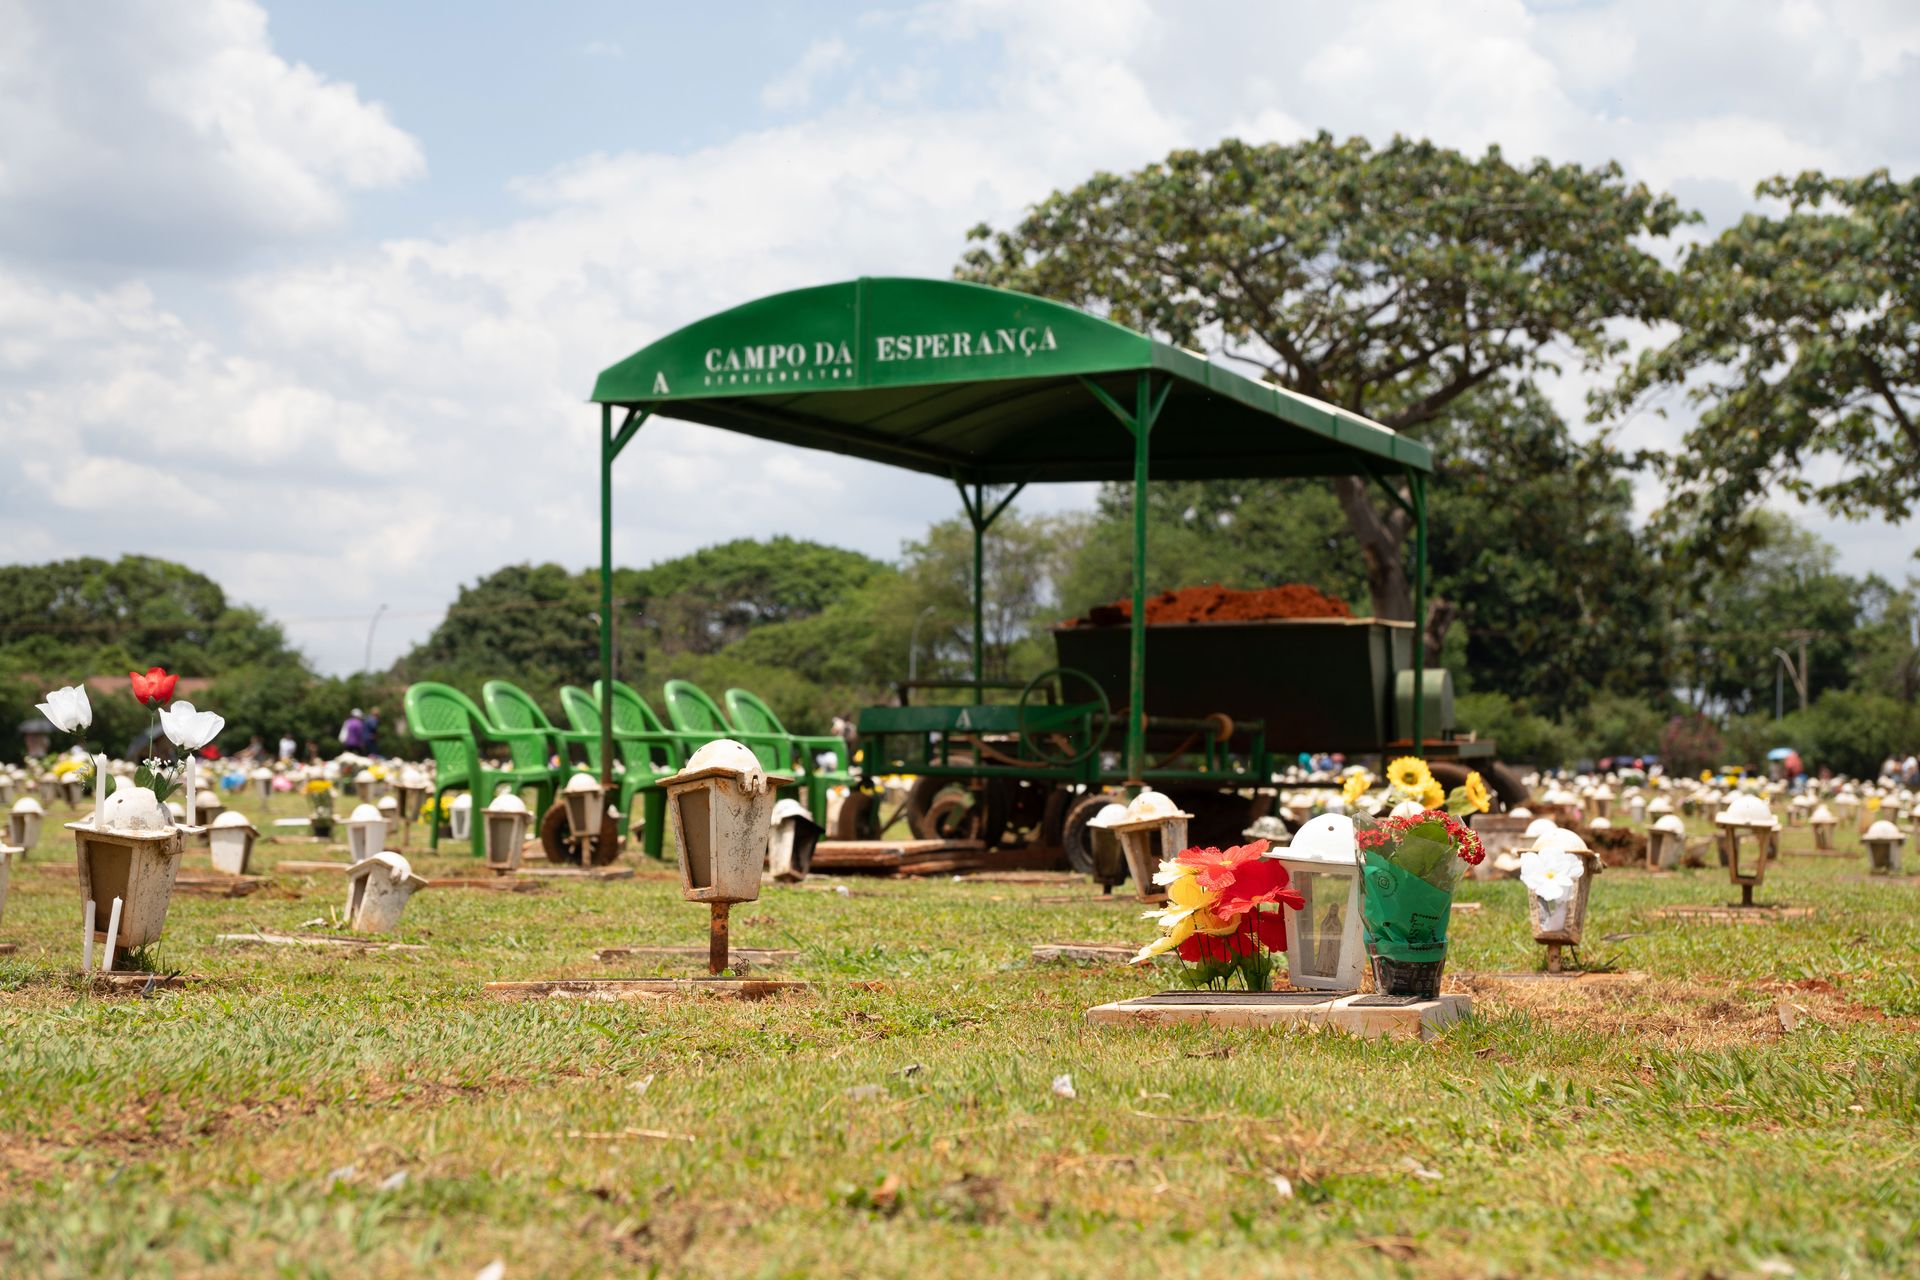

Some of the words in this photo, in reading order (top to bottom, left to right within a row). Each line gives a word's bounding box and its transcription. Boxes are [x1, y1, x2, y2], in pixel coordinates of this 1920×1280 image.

[705, 343, 807, 373] CAMPO
[814, 339, 853, 366] DA
[876, 325, 1058, 362] ESPERANÇA
